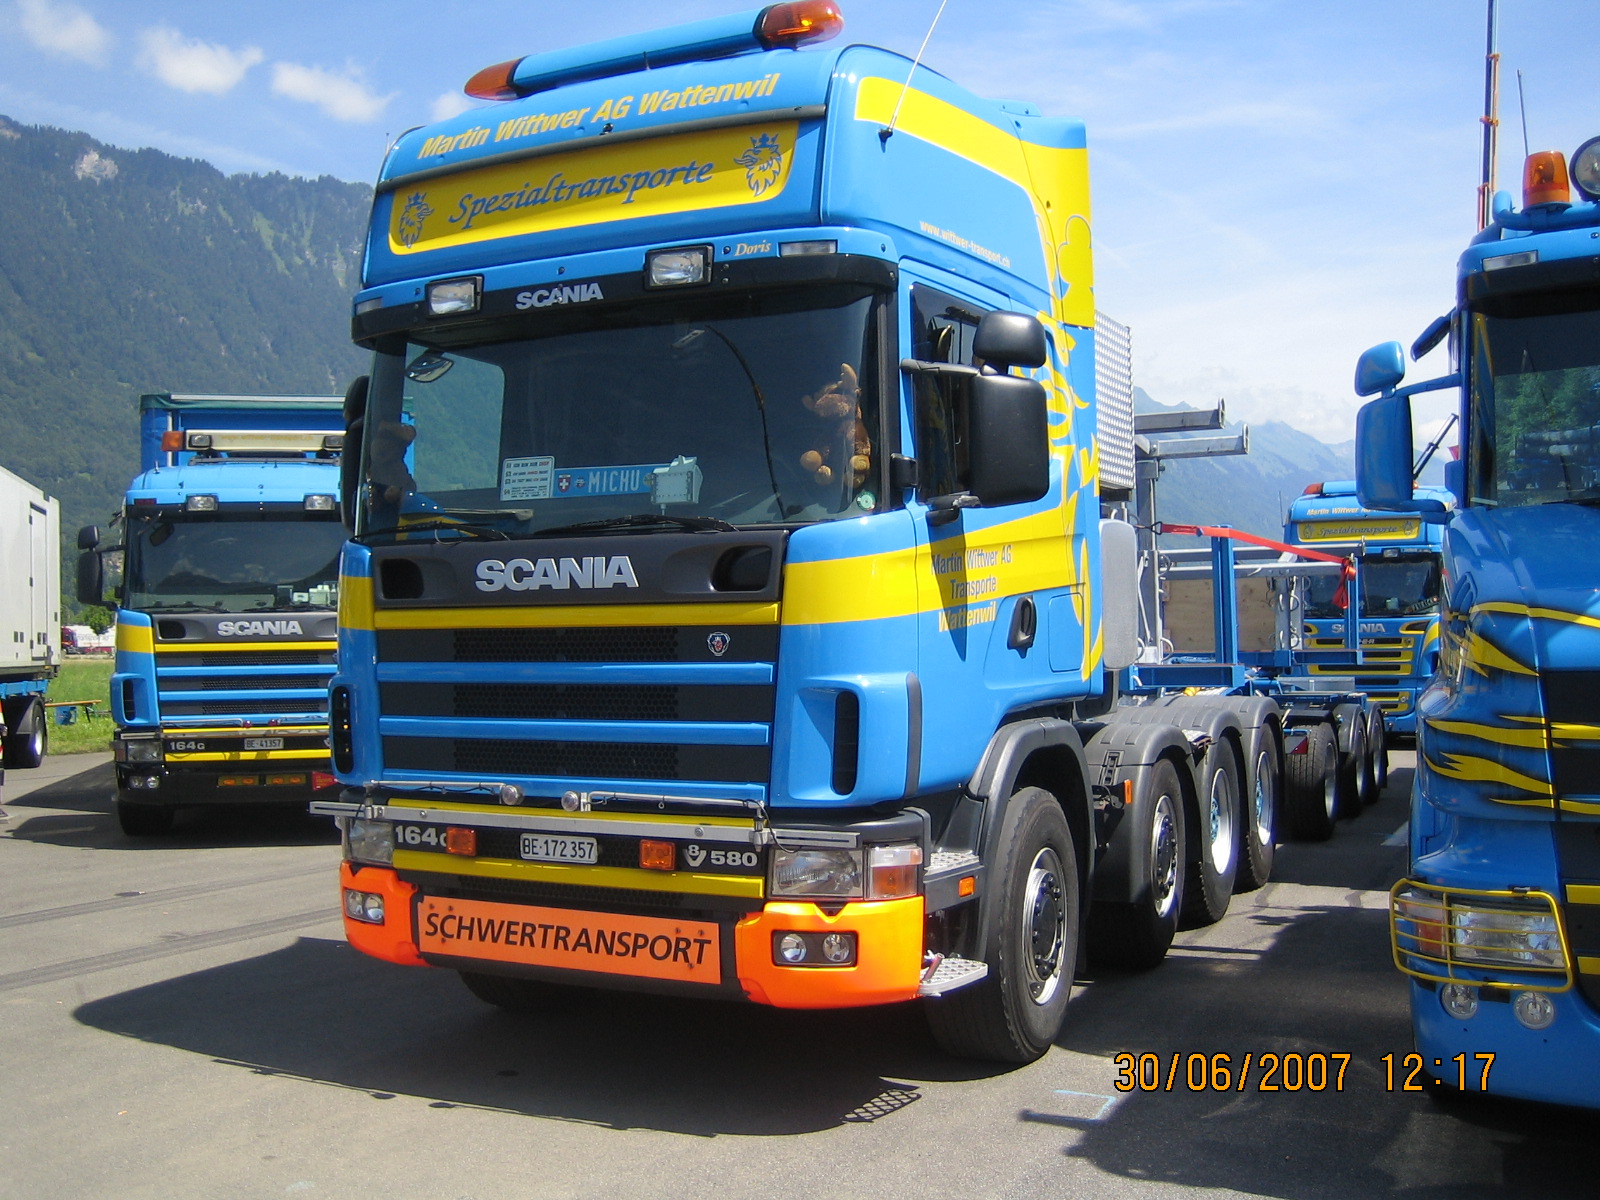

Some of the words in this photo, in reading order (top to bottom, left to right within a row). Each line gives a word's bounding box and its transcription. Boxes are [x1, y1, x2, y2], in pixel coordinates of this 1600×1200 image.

[417, 126, 491, 159] Martin
[494, 107, 592, 143] Wittwer
[591, 95, 635, 124] AG
[637, 72, 781, 116] Wattenwil
[448, 160, 715, 230] Spezialtransporte
[734, 240, 772, 256] Doris
[515, 282, 604, 310] SCANIA
[587, 469, 641, 493] MICHU
[475, 555, 639, 592] SCANIA
[931, 552, 964, 576] Martin
[965, 548, 999, 570] Wittwer
[1001, 544, 1013, 565] AG
[950, 574, 997, 600] Transporte
[217, 620, 304, 637] SCANIA
[938, 601, 998, 633] Wattenwil
[1331, 623, 1386, 633] SNIA
[170, 741, 206, 750] 164G
[710, 850, 758, 867] 580
[425, 911, 712, 966] SCHWERTRANSPORT
